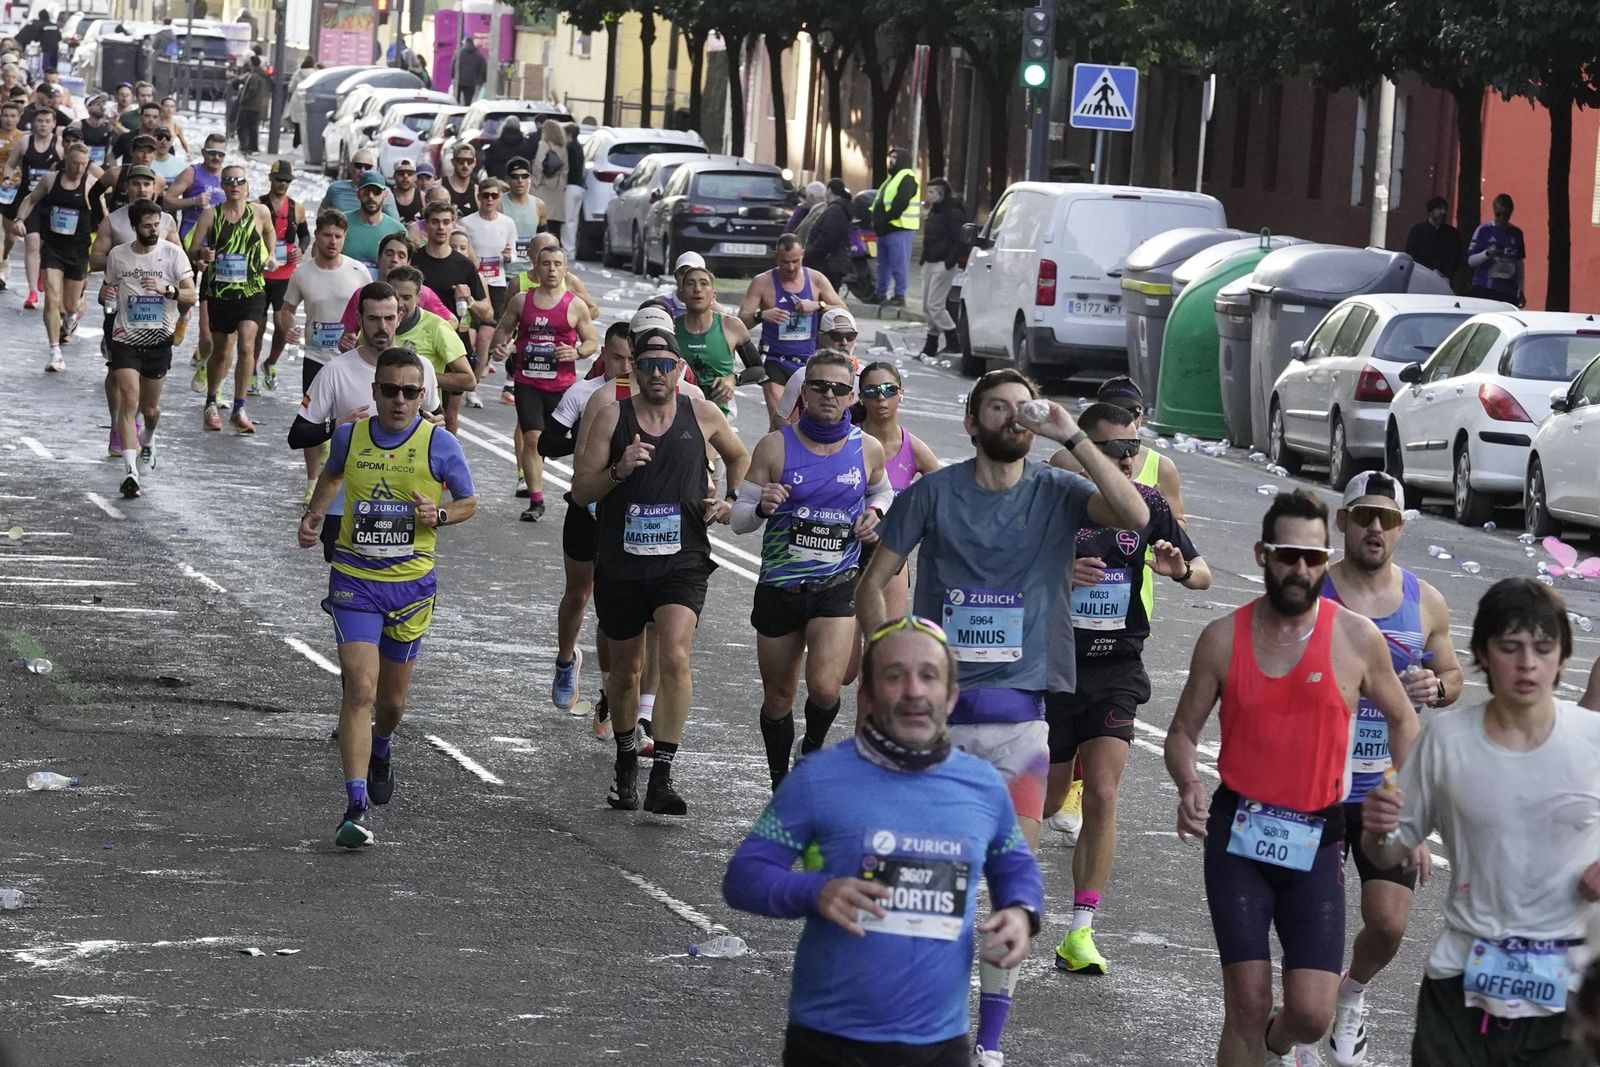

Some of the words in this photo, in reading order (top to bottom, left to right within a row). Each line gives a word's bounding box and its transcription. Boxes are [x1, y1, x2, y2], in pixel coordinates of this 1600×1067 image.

[1075, 302, 1101, 313] 9177
[1103, 304, 1122, 314] MFY
[528, 362, 551, 371] MARIO
[356, 461, 385, 471] GPDM
[386, 465, 415, 473] Lecce
[373, 504, 408, 512] ZURICH
[643, 506, 674, 515] ZURICH
[813, 510, 845, 520] ZURICH
[373, 520, 393, 529] 4859
[811, 526, 830, 535] 4563
[356, 531, 410, 544] GAETANO
[625, 531, 679, 543] MARTINEZ
[795, 534, 843, 550] ENRIQUE
[969, 593, 1015, 605] ZURICH
[1089, 590, 1110, 600] 6033
[1076, 602, 1119, 615] JULIEN
[969, 615, 994, 626] 5964
[957, 629, 1006, 644] MINUS
[1090, 644, 1113, 652] RESS
[1359, 728, 1383, 739] 5732
[1263, 825, 1290, 840] 5808
[902, 837, 961, 855] ZURICH
[1255, 839, 1288, 861] CAO
[899, 866, 934, 884] 3607
[1475, 972, 1556, 1001] OFFGRID
